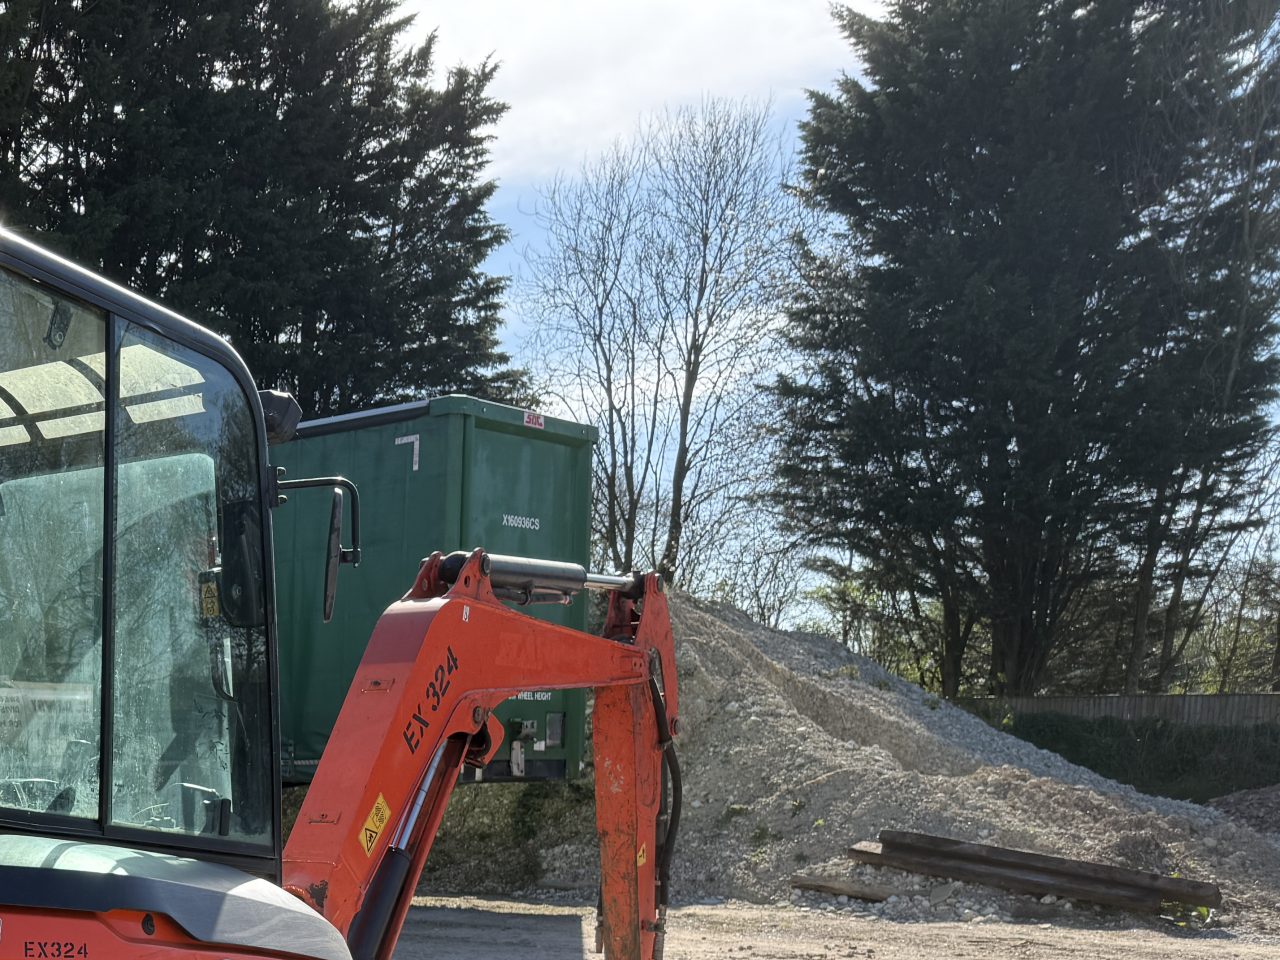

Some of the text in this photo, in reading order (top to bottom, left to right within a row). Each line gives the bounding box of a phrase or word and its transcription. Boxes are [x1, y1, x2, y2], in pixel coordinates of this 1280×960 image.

[502, 513, 540, 530] X160936CS
[403, 645, 459, 754] EX 324
[534, 691, 552, 701] HEIGHT
[24, 941, 89, 958] EX324
